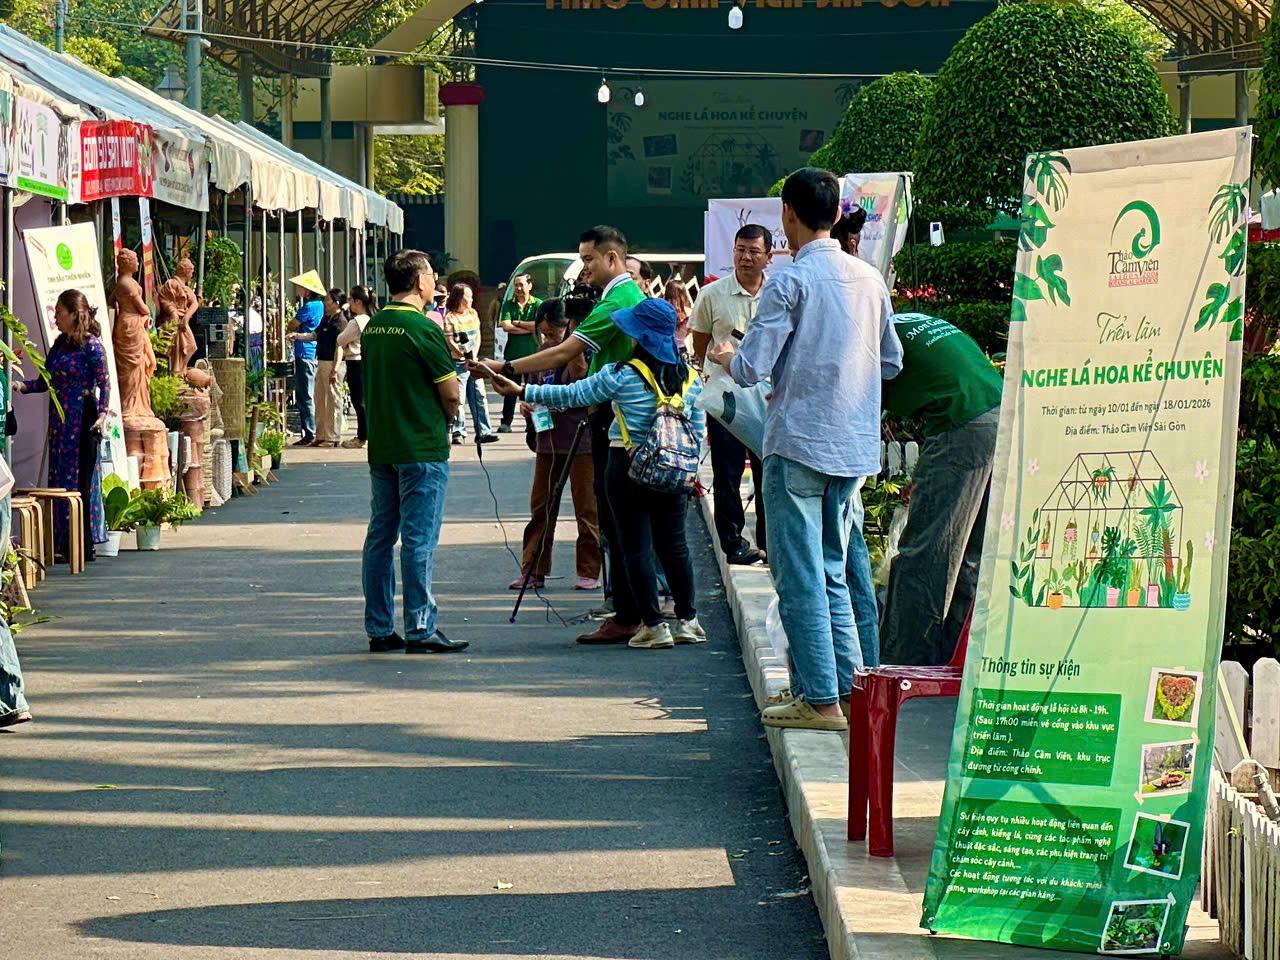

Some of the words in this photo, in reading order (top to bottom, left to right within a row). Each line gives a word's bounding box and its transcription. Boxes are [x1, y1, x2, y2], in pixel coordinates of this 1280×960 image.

[659, 111, 691, 121] NGHE
[711, 111, 737, 121] HOA
[860, 196, 875, 209] DIY
[387, 326, 405, 335] ZOO
[905, 322, 928, 340] Mon
[1097, 311, 1131, 344] Triển
[1135, 315, 1161, 342] lãm
[1020, 368, 1068, 388] NGHE
[1071, 358, 1091, 386] LÁ
[1093, 365, 1129, 385] HOA
[1132, 349, 1153, 383] KỂ
[1154, 351, 1224, 386] CHUYỆN
[1041, 406, 1058, 416] Thời
[1059, 406, 1077, 418] gian:
[1079, 404, 1088, 414] từ
[1089, 405, 1106, 418] ngày
[1108, 403, 1129, 414] 10/01
[1130, 401, 1143, 412] đến
[1163, 398, 1211, 411] 18/01/2026
[1065, 425, 1078, 436] Địa
[1079, 424, 1100, 436] điểm:
[1101, 423, 1120, 434] Thảo
[1154, 421, 1167, 432] Sài
[1168, 421, 1186, 432] Gòn
[981, 656, 1019, 677] Thông
[1021, 658, 1036, 675] tin
[1039, 663, 1055, 679] sự
[1056, 659, 1081, 680] kiện
[975, 715, 993, 726] (Sau
[995, 716, 1019, 726] 17h00
